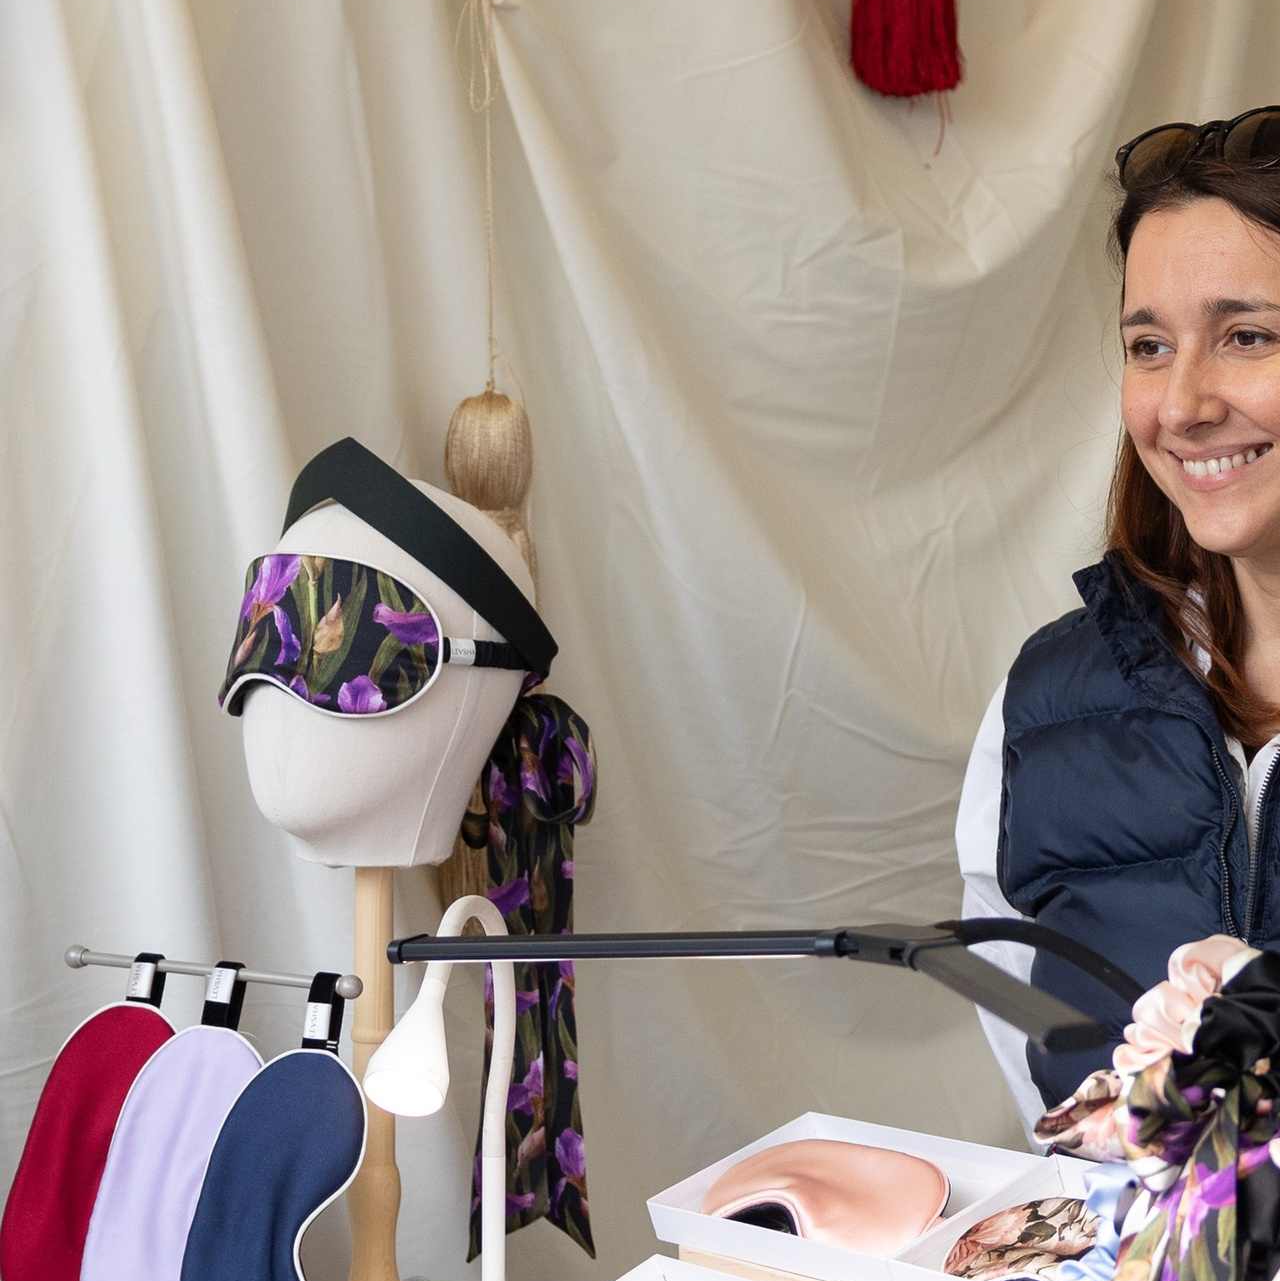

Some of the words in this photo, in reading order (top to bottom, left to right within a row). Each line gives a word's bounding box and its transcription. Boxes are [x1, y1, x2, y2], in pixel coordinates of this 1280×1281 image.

[131, 963, 142, 996] LEVSHA
[212, 968, 224, 1000] LEVSHA
[309, 1004, 319, 1038] LEVSHA
